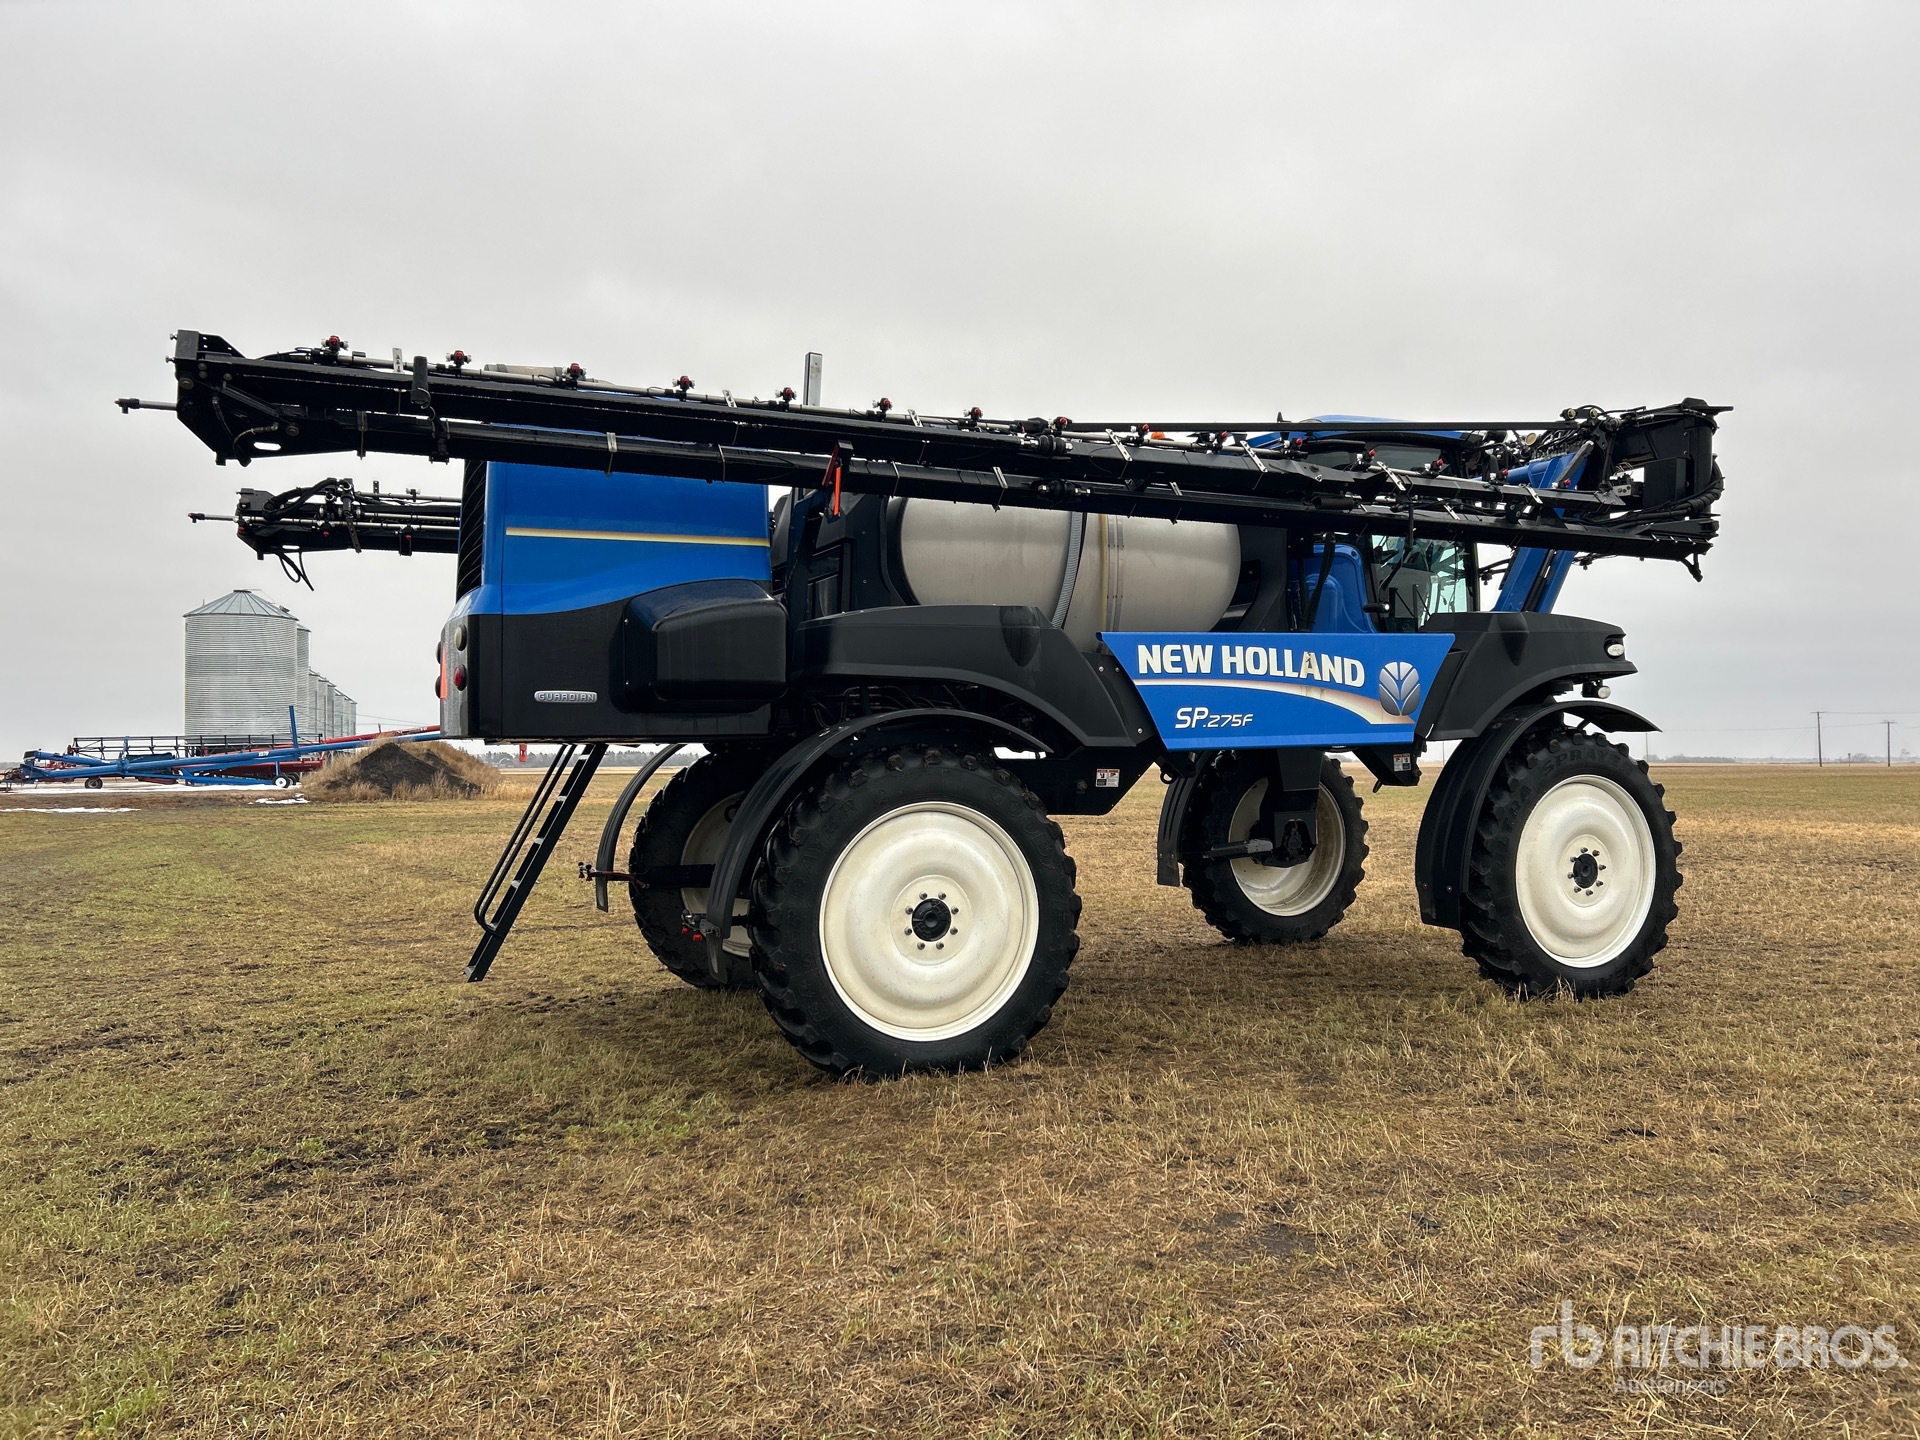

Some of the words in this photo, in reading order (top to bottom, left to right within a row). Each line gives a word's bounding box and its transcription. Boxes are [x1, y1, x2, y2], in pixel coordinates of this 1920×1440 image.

[1137, 644, 1214, 675] NEW
[1221, 645, 1366, 688] HOLLAND
[538, 692, 595, 702] GUARDIAN
